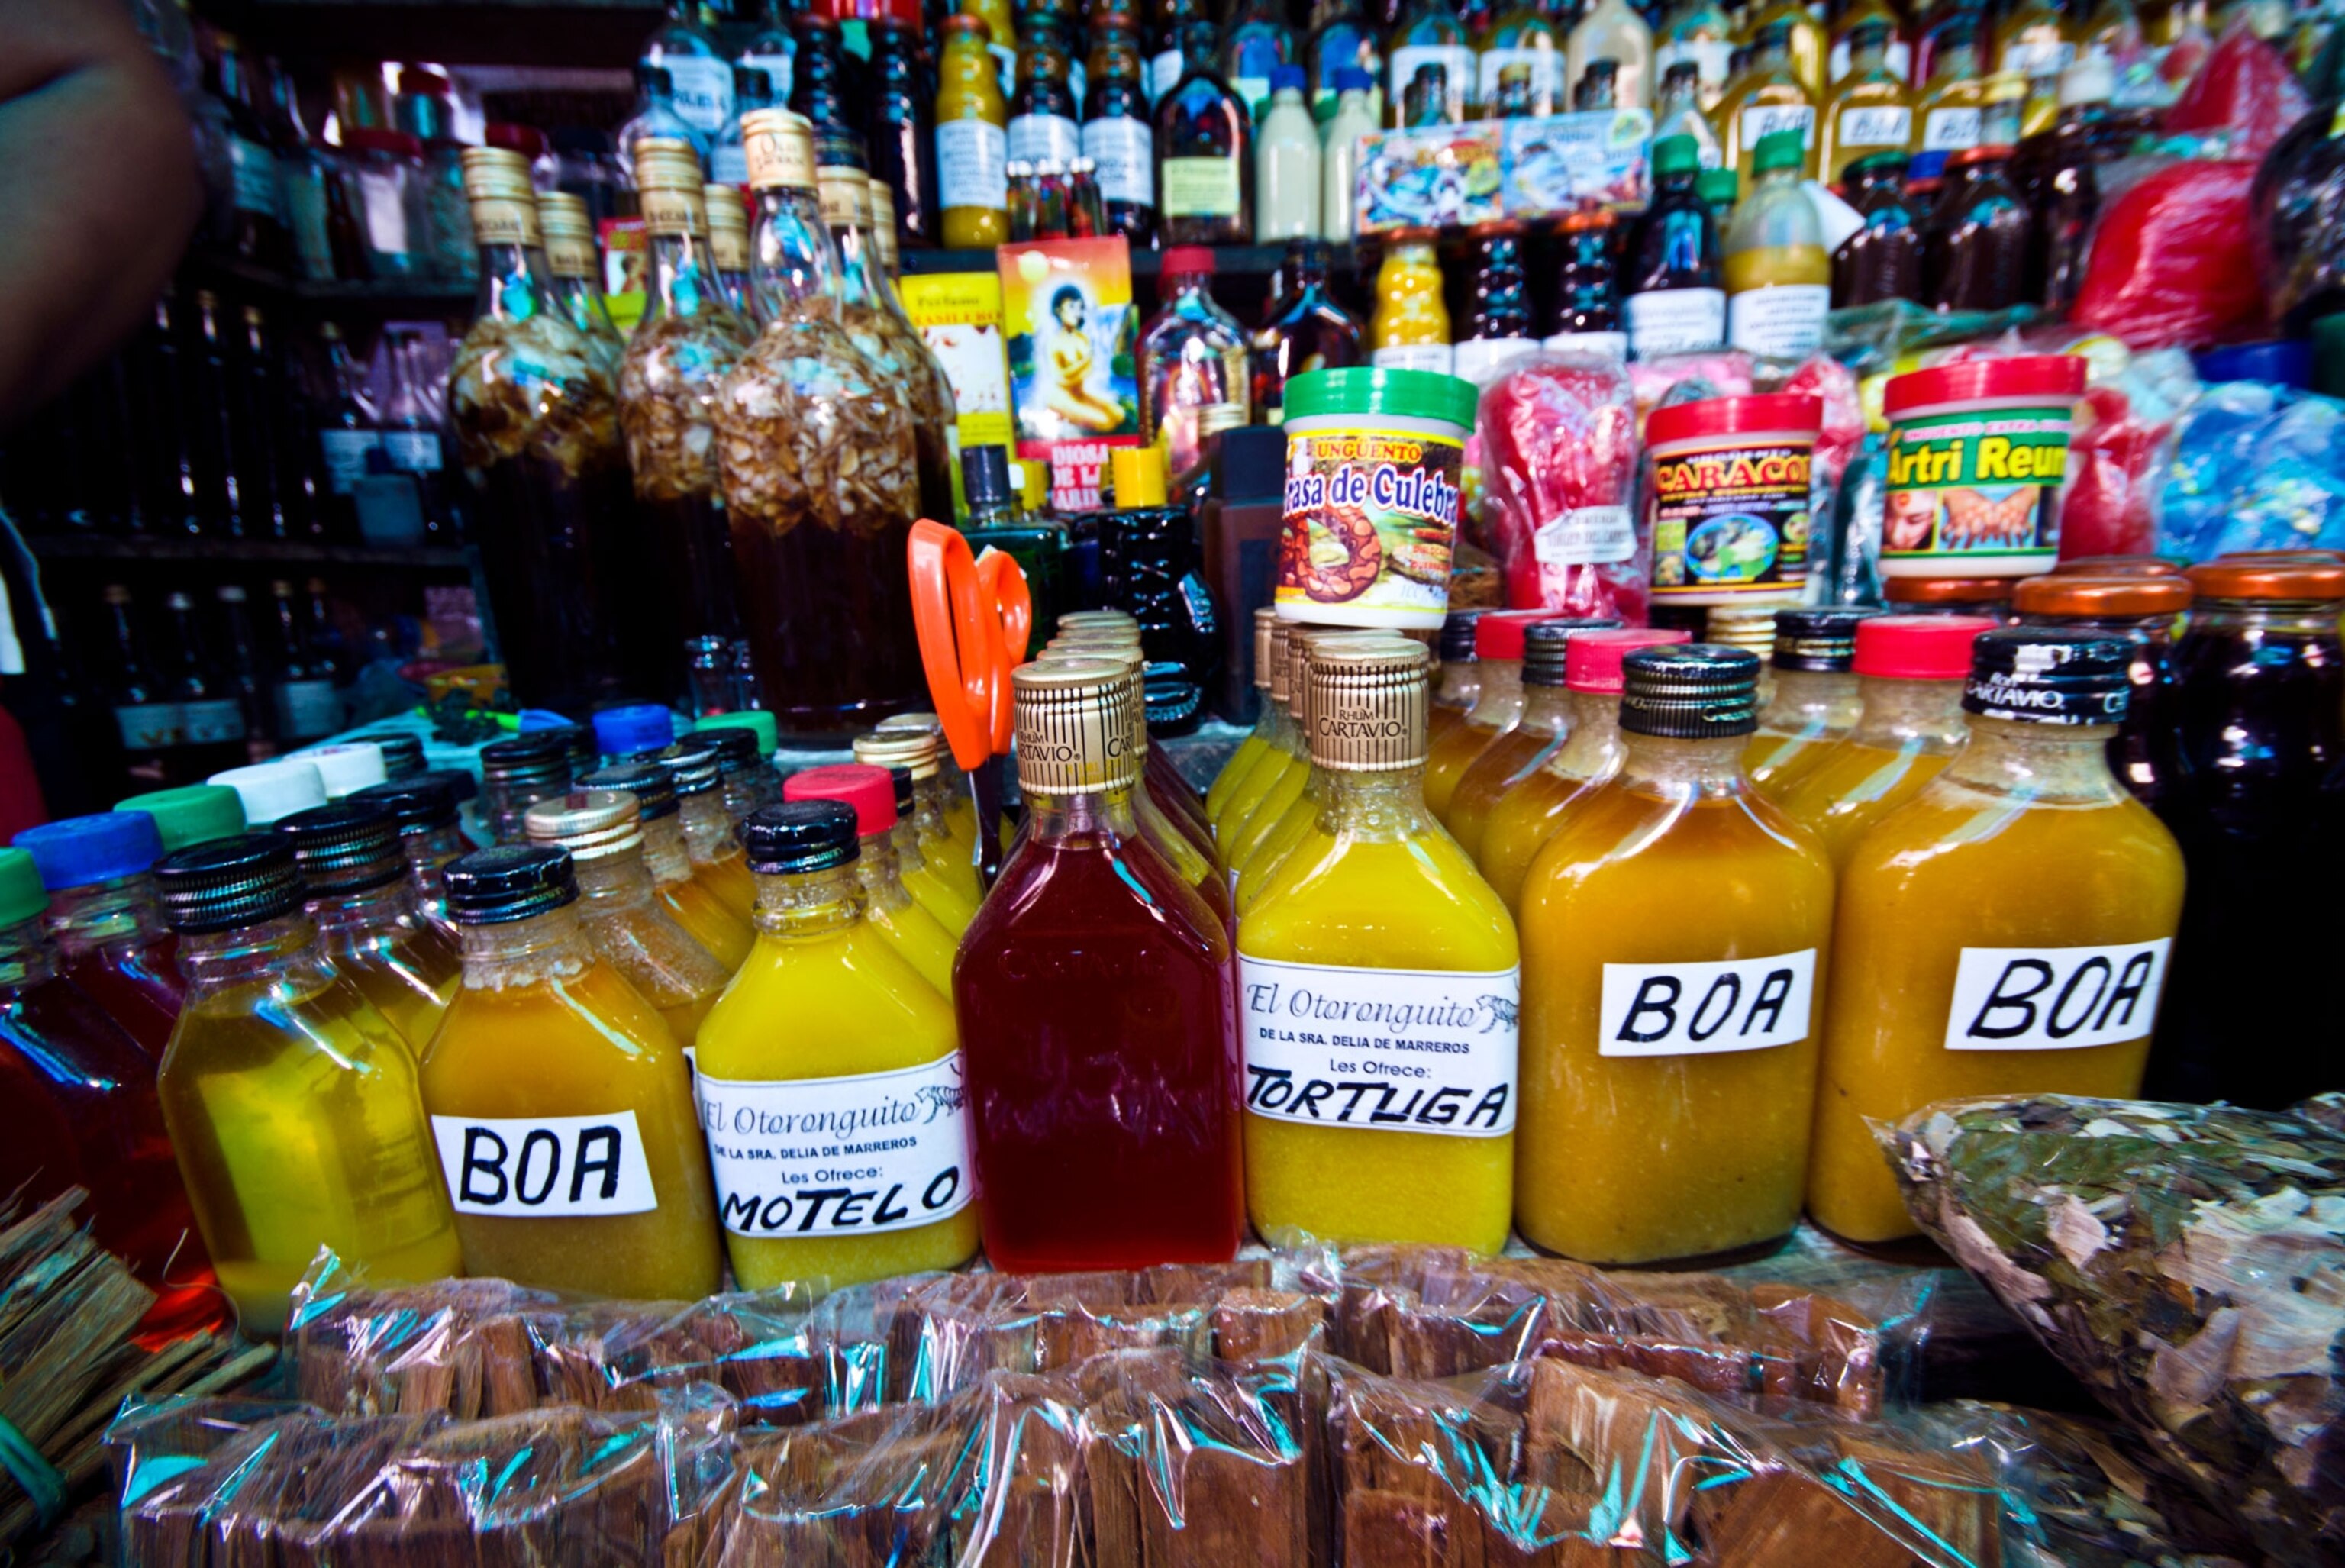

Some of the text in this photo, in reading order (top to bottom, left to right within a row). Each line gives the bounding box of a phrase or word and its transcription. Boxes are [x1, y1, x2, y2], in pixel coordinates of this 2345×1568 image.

[1317, 440, 1421, 461] UNGÜENTO
[1286, 473, 1324, 512] rasa
[1332, 465, 1366, 504] de
[1319, 718, 1402, 738] CARTAVIO
[1339, 708, 1374, 721] RHUM
[1019, 743, 1073, 762] RTAVIO
[1247, 983, 1480, 1034] El Otoronguito
[1615, 968, 1794, 1043] BOA
[1966, 950, 2154, 1039] BOA
[1260, 1027, 1469, 1054] DE LA SRA. DELIA DE MARREROS
[1330, 1058, 1431, 1079] Les Ofrece:
[1247, 1063, 1509, 1128] TORTUGA
[702, 1095, 920, 1140] El Otoronguito
[459, 1124, 622, 1206] BOA
[714, 1136, 918, 1160] DE LA SRA. DELIA DE MARREROS
[782, 1166, 883, 1185] Les Ofrece:
[722, 1165, 960, 1231] MOTELO
